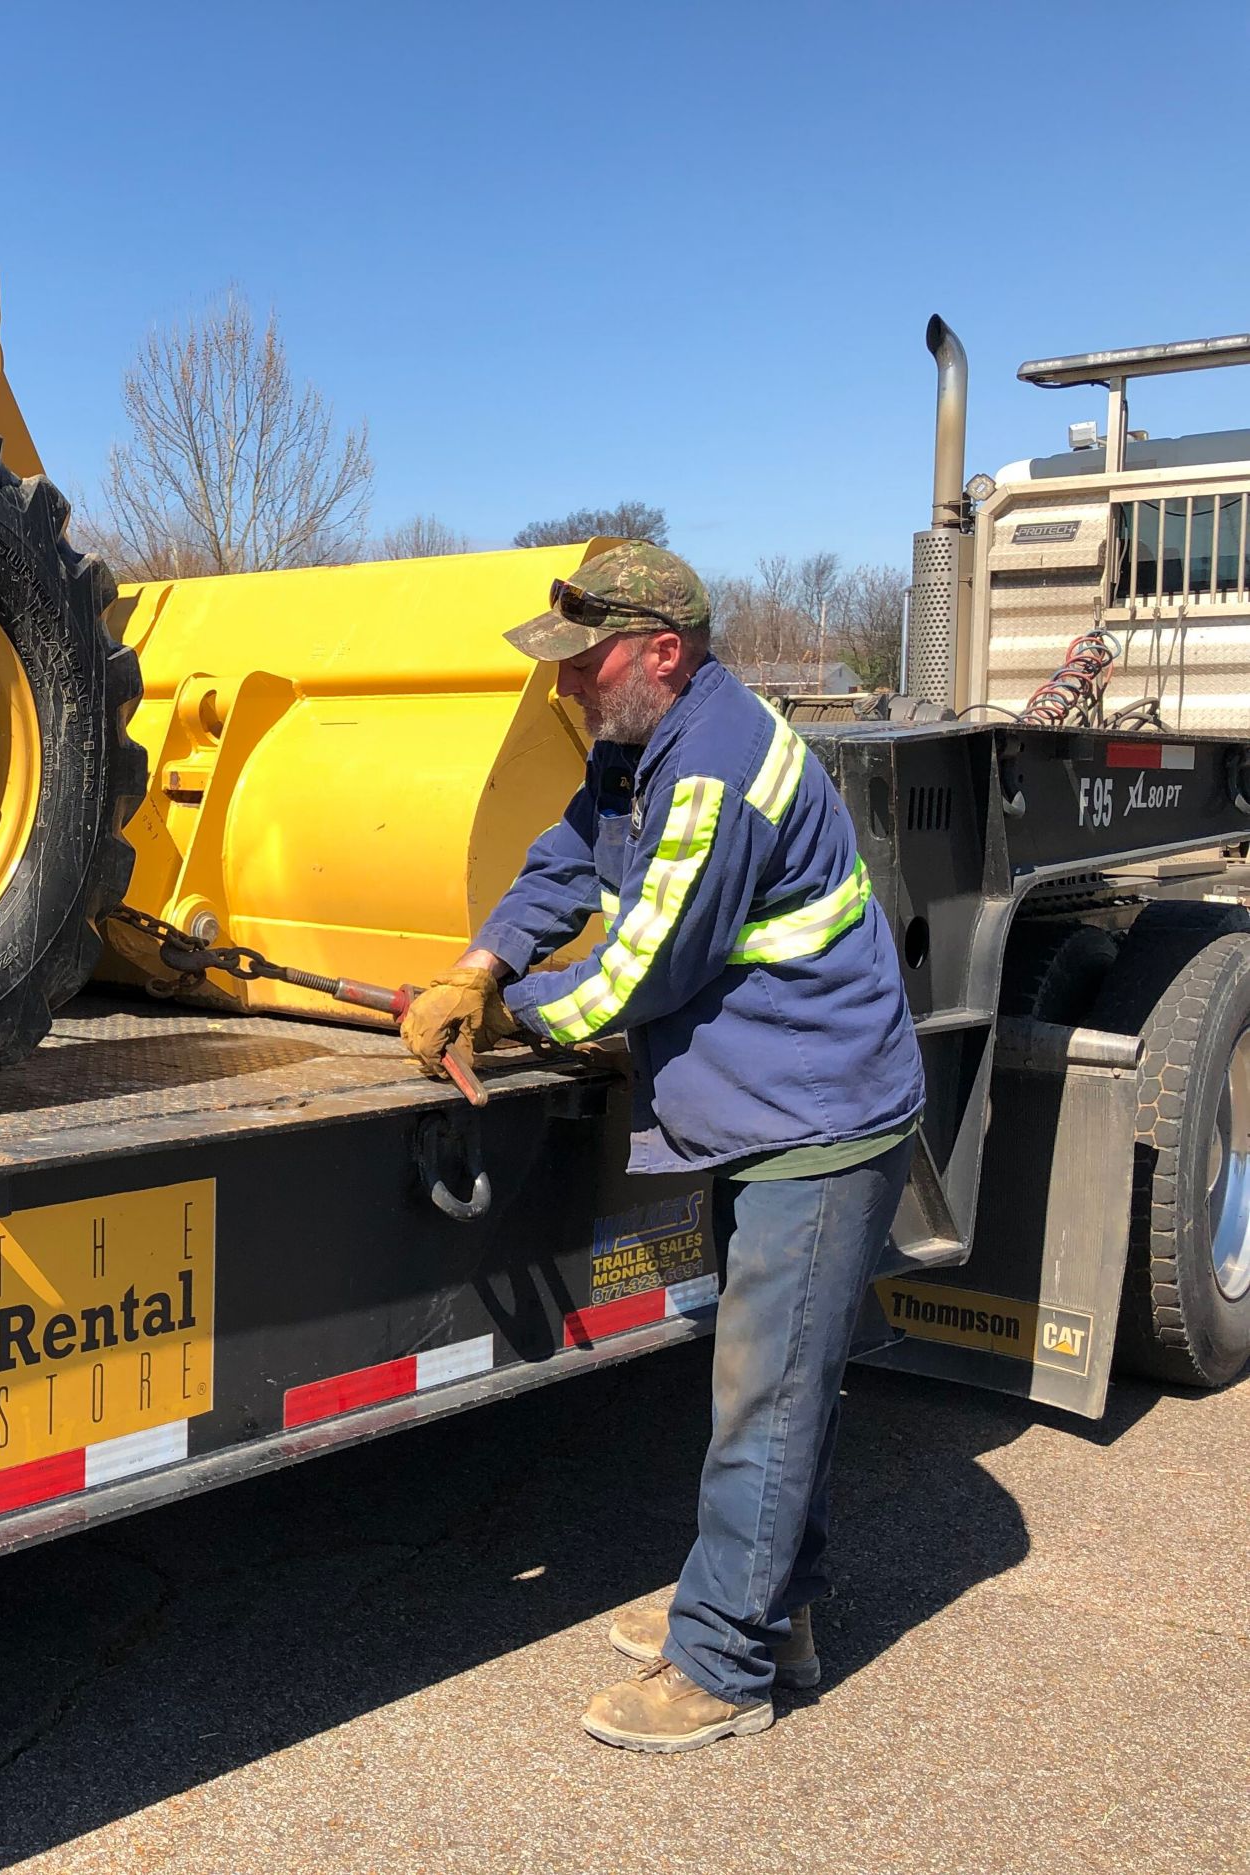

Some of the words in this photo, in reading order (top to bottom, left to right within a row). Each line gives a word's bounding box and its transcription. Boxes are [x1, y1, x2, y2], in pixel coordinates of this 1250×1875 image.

[1017, 524, 1078, 536] PROTECH
[592, 1245, 655, 1274] TRAILER
[659, 1232, 703, 1256] SALES
[592, 1256, 676, 1287] MONROE,
[680, 1249, 703, 1263] LA
[891, 1291, 1021, 1340] Thompson
[1042, 1321, 1086, 1358] CAT
